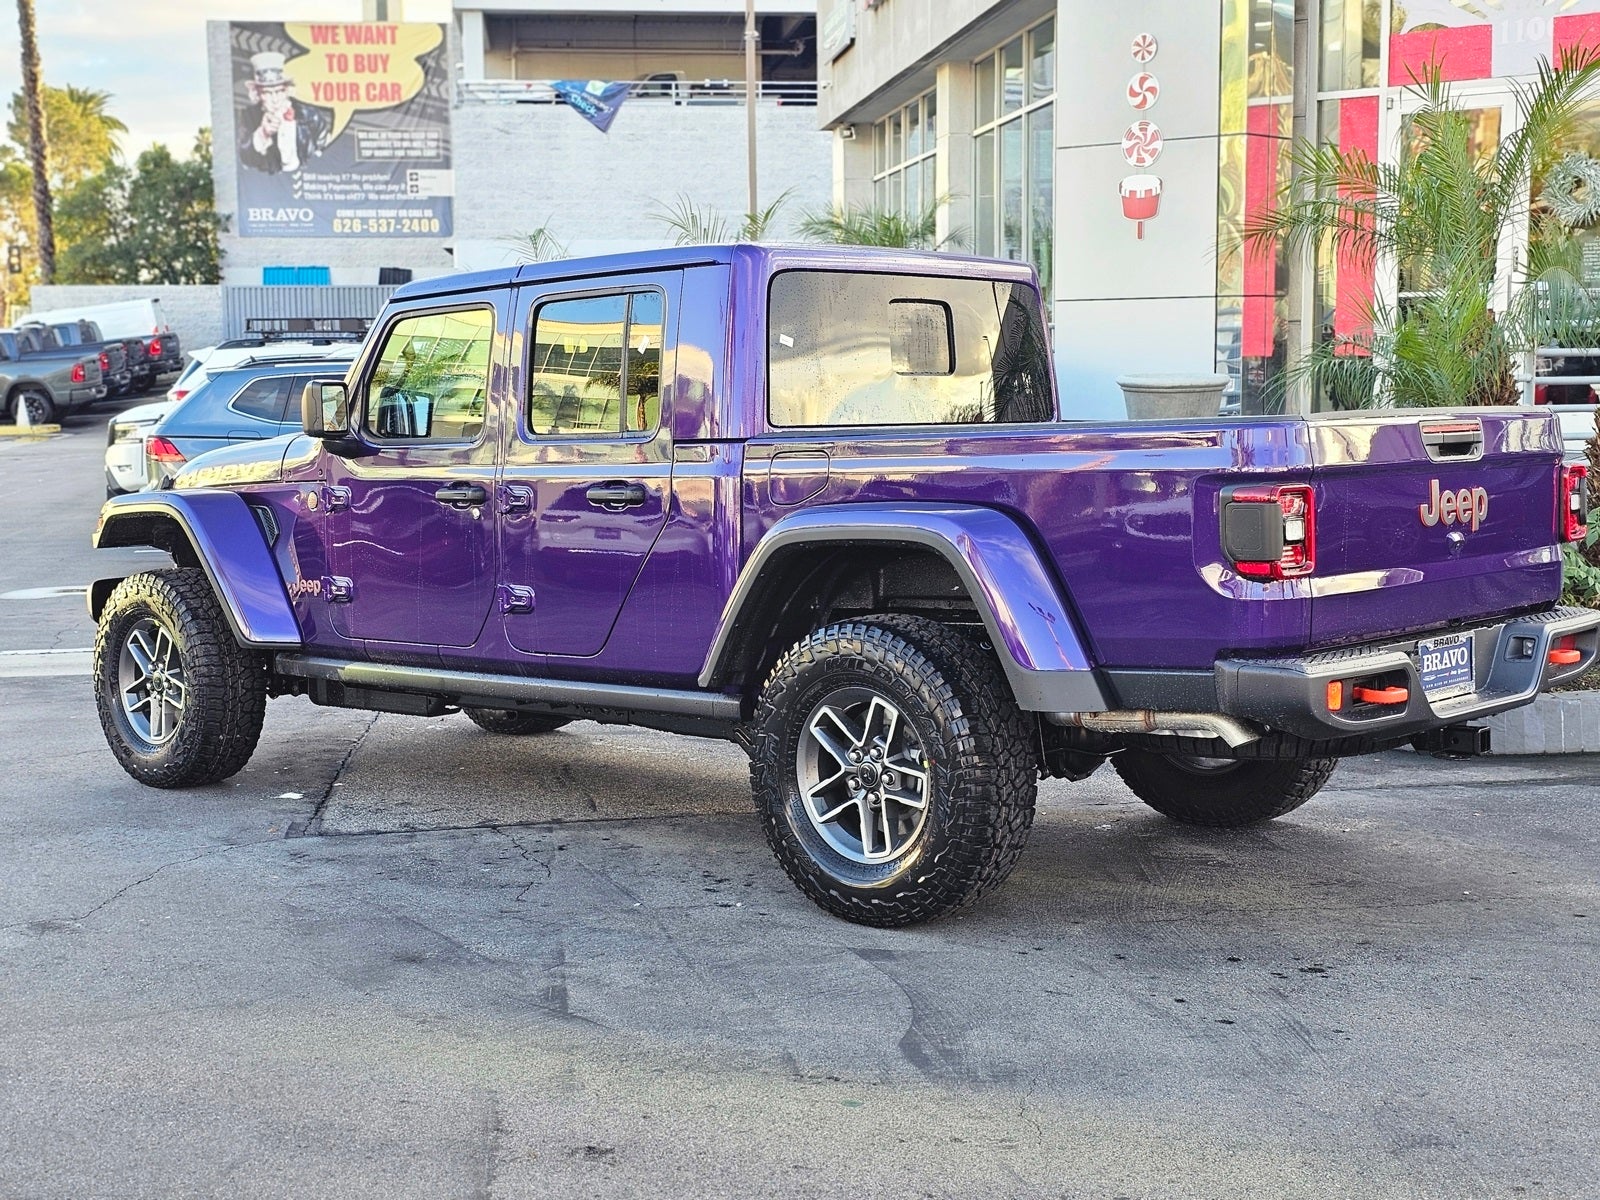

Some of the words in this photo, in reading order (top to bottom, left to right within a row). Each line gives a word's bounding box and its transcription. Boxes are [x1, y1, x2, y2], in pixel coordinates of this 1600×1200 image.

[310, 25, 340, 45] WE
[343, 25, 398, 45] WANT
[325, 53, 348, 73] TO
[353, 53, 390, 73] BUY
[311, 82, 360, 102] YOUR
[365, 82, 402, 102] CAR
[248, 208, 314, 222] BRAVO
[1420, 479, 1488, 533] Jeep
[291, 574, 321, 597] Jeep
[1433, 635, 1459, 648] BRAVO
[1422, 647, 1468, 673] BRAVO
